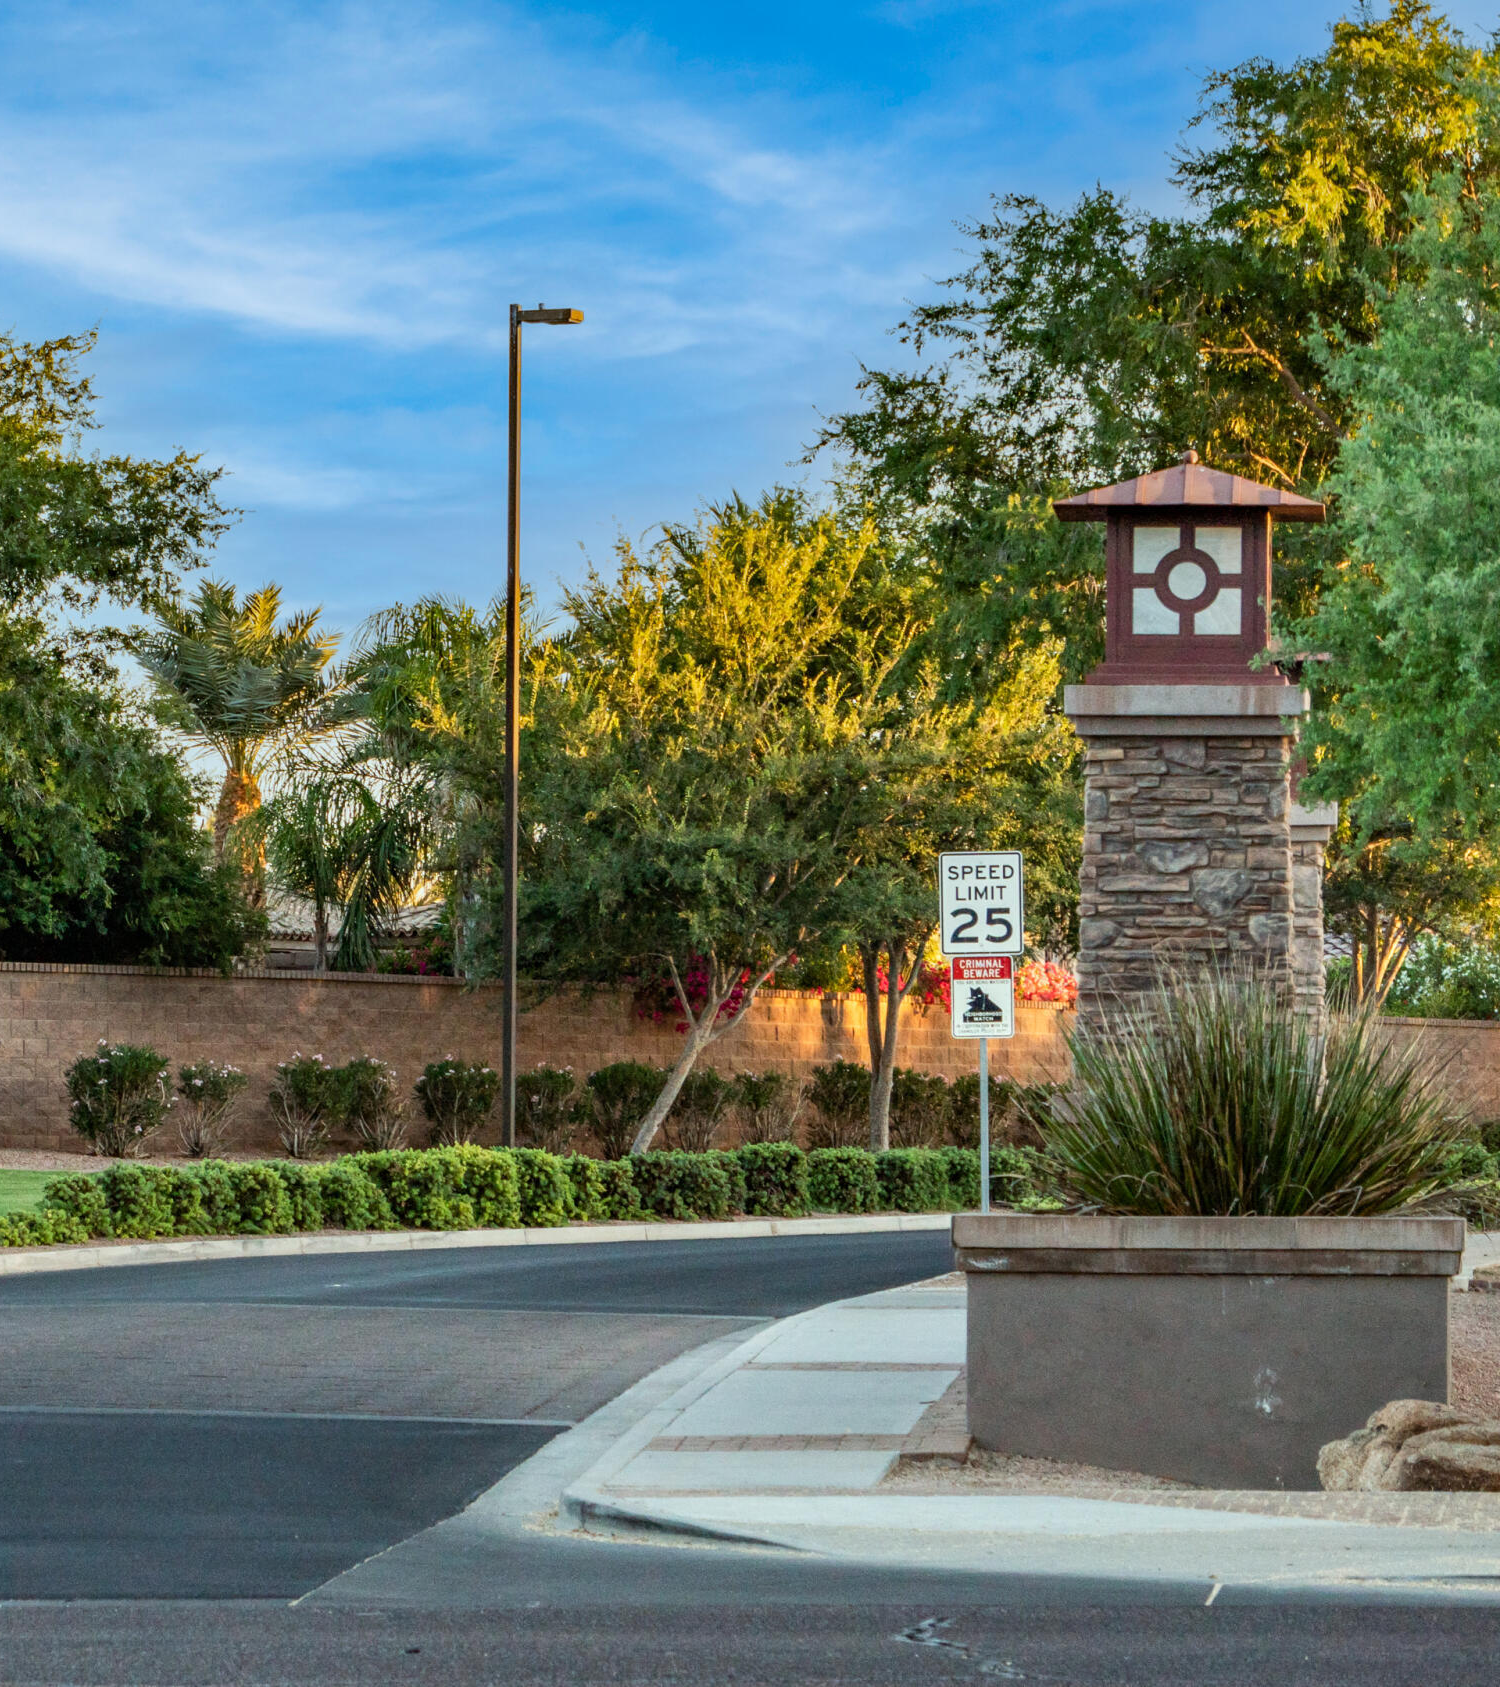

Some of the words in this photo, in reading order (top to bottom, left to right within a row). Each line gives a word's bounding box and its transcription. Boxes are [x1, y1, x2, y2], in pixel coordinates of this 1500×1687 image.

[948, 865, 1014, 880] SPEED
[956, 886, 1007, 900] LIMIT
[950, 907, 1013, 943] 25
[959, 959, 1004, 969] CRIMINAL
[963, 968, 1001, 978] BEWARE
